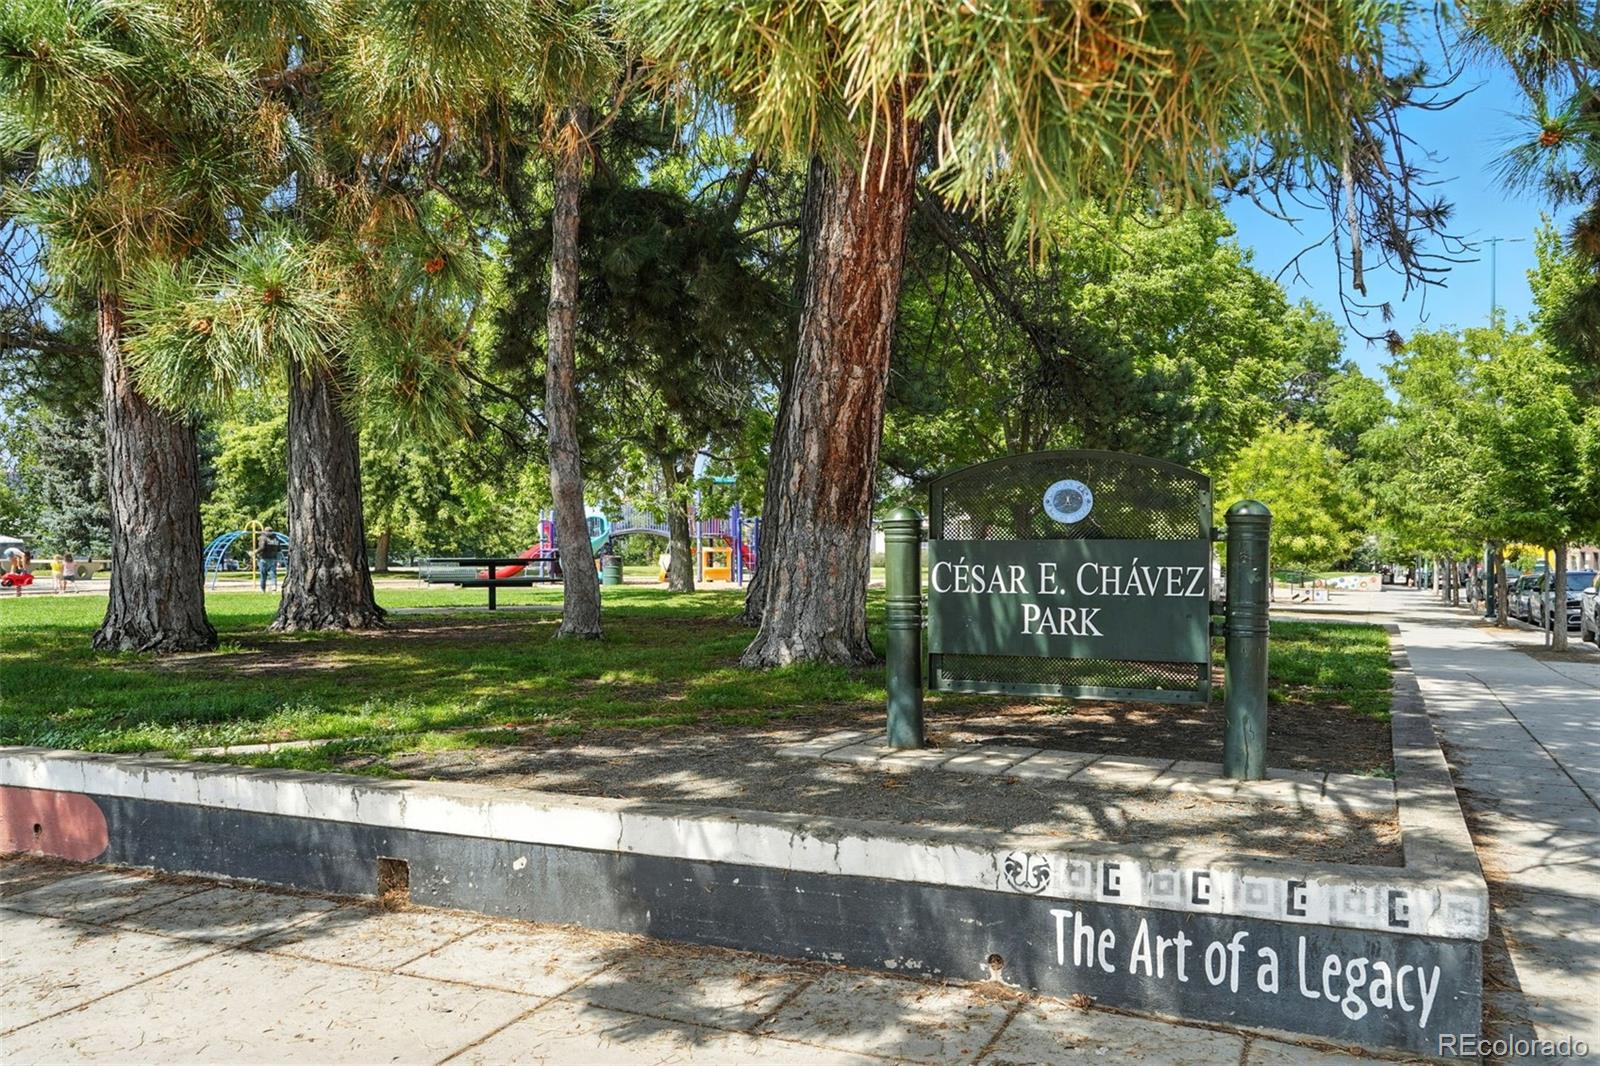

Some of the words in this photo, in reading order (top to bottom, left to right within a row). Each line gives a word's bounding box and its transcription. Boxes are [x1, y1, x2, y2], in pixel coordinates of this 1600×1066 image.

[931, 556, 1029, 594] CÉSAR
[1038, 562, 1066, 595] E.
[1076, 557, 1205, 597] CHÁVEZ
[1021, 603, 1104, 637] PARK
[1049, 908, 1116, 973] The
[1129, 918, 1192, 982] Art
[1205, 931, 1250, 993] of
[1257, 946, 1279, 994] a
[1298, 936, 1441, 1029] Legacy
